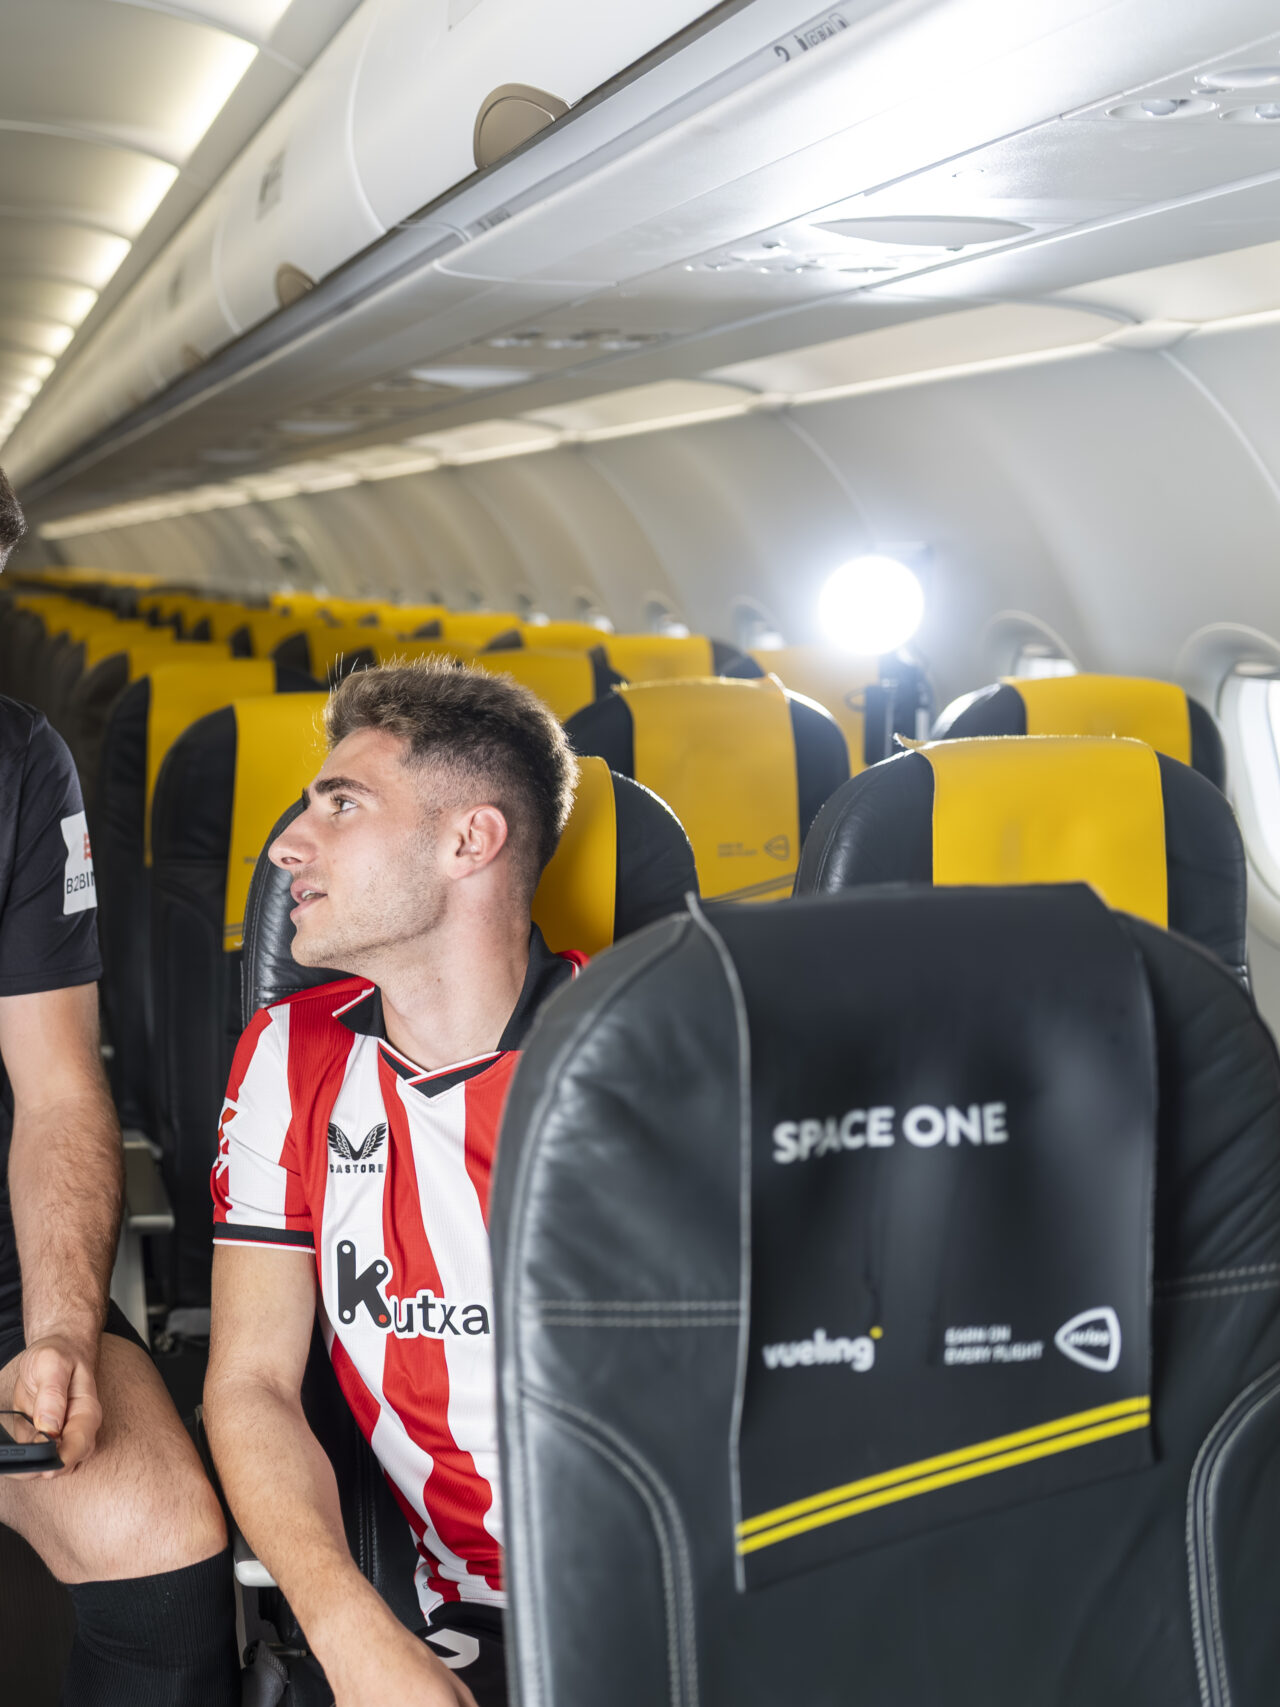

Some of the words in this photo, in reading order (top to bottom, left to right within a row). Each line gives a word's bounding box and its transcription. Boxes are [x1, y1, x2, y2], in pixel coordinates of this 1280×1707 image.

[772, 1105, 896, 1165] SPACE
[902, 1101, 1009, 1148] ONE
[329, 1163, 385, 1174] CASTORE
[761, 1326, 877, 1373] vueling
